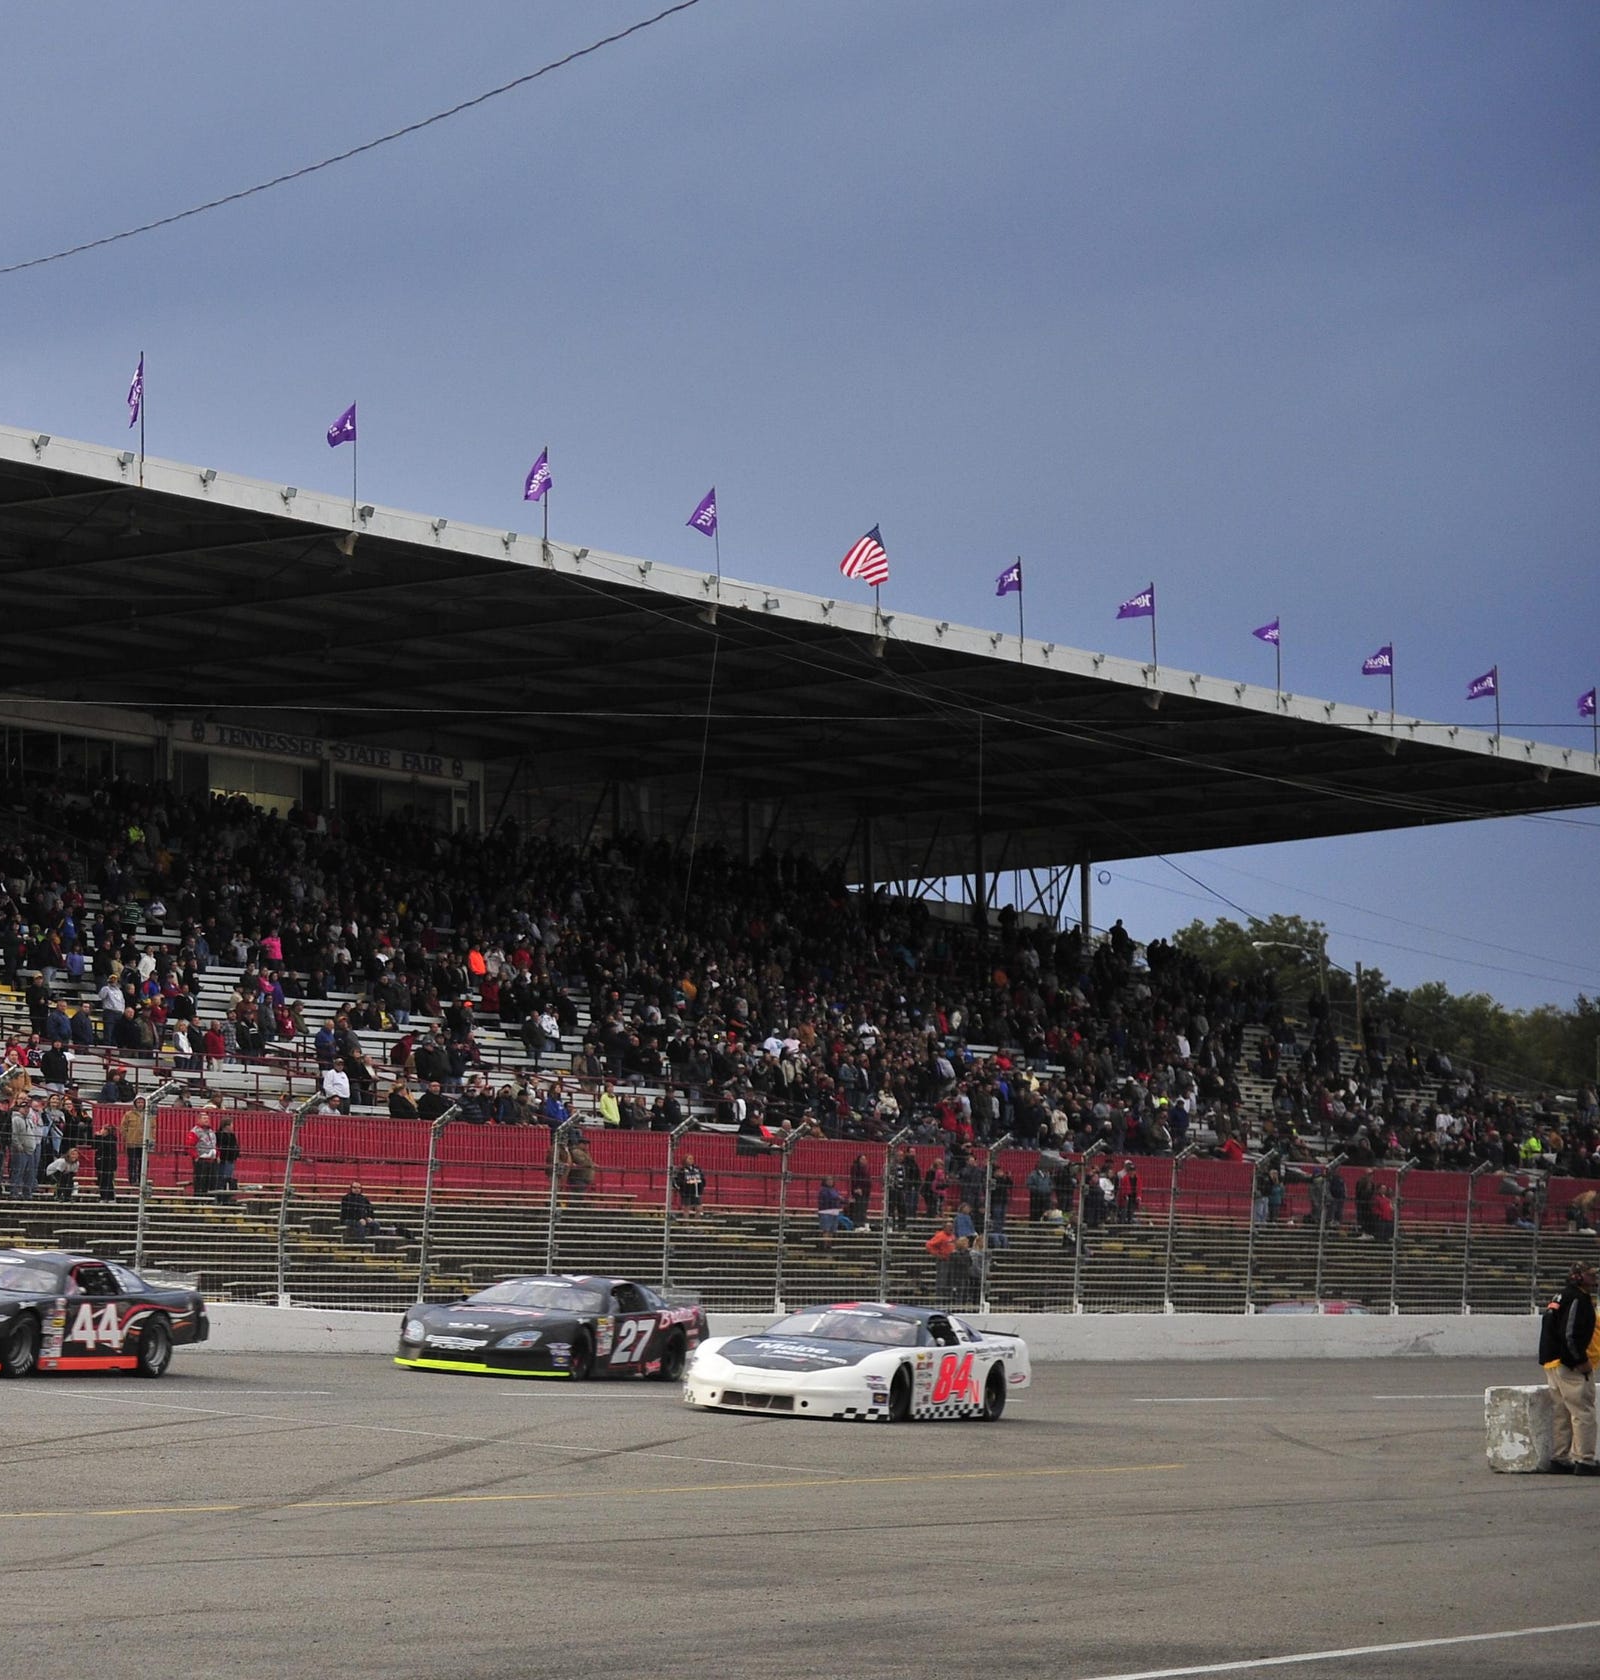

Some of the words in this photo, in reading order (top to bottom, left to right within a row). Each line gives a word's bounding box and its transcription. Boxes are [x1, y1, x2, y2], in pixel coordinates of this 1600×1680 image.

[216, 726, 323, 754] TENNESSEE
[336, 744, 390, 766] STATE
[401, 751, 443, 773] FAIR
[71, 1302, 125, 1351] 44
[609, 1318, 656, 1364] 27
[931, 1352, 975, 1405] 84
